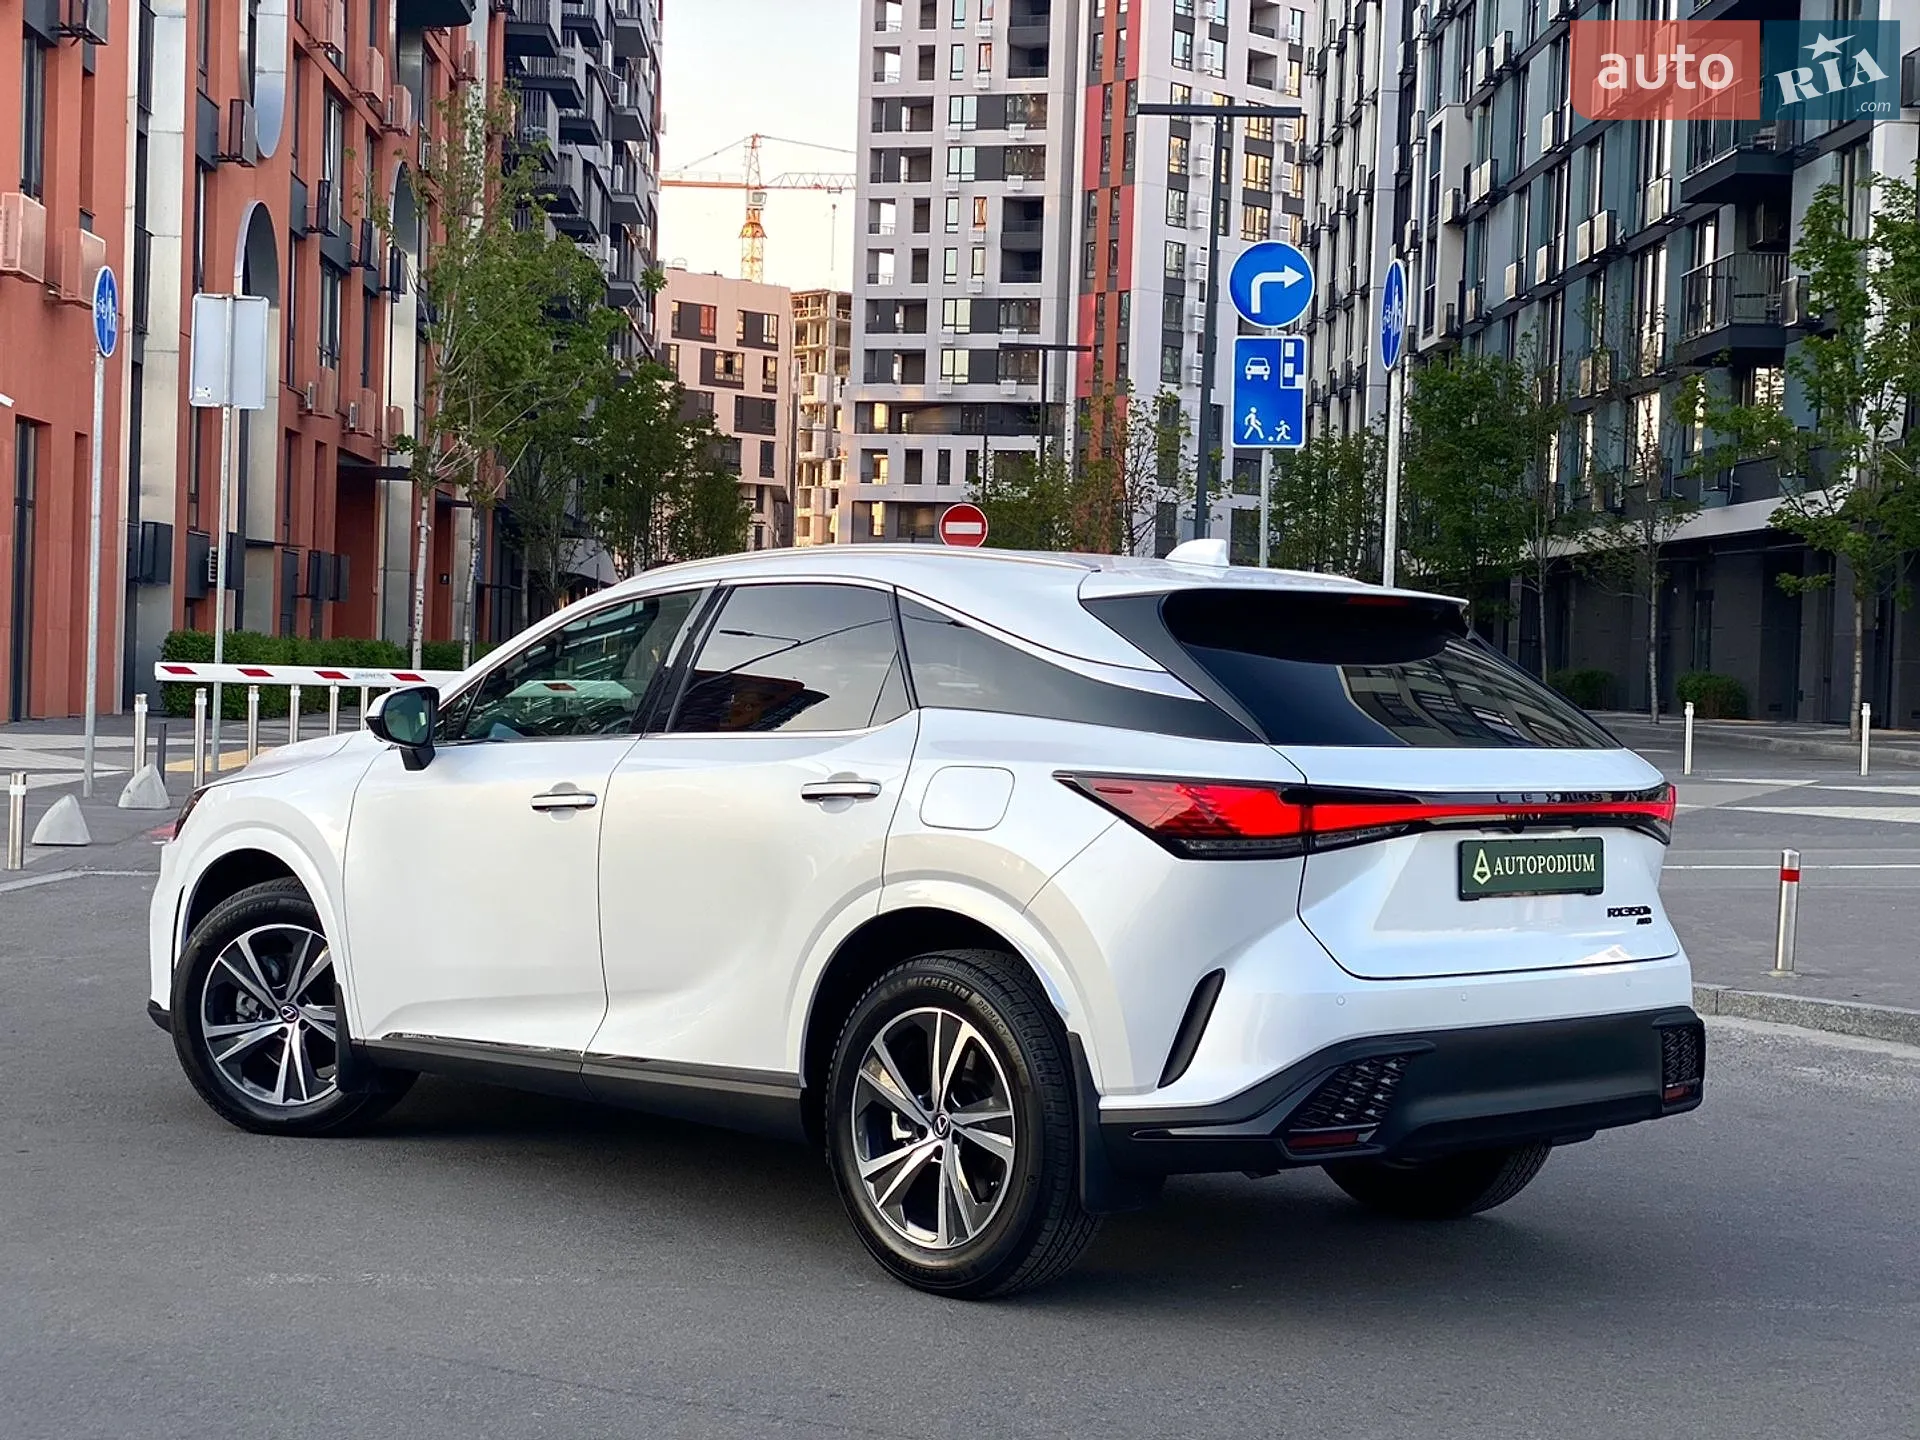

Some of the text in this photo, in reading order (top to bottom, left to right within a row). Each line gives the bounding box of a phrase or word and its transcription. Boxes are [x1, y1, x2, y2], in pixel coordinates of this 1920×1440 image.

[1493, 853, 1596, 876] AUTOPODIUM
[906, 976, 970, 1000] MICHELIN
[976, 999, 1009, 1039] PRIMACY
